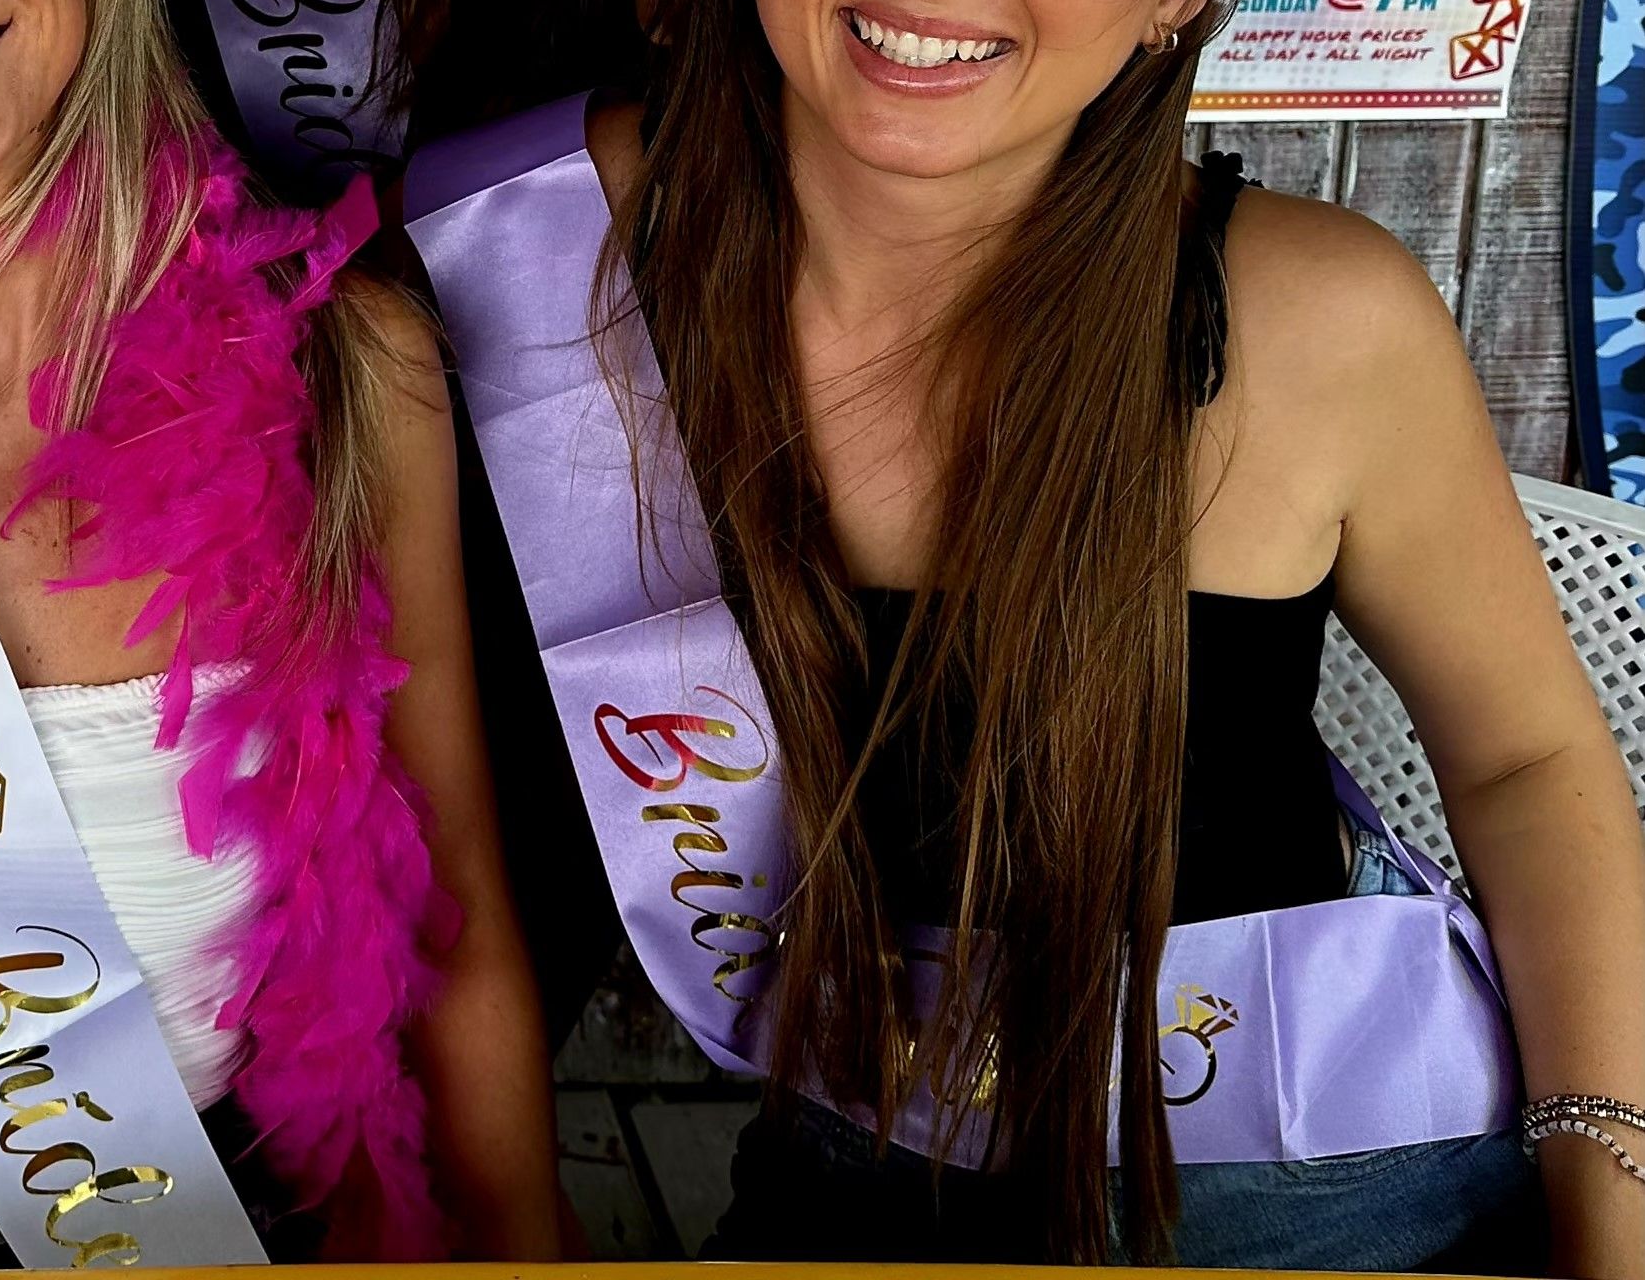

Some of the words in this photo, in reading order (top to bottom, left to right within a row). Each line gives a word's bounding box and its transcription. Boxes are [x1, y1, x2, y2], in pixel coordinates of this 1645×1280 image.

[1232, 30, 1295, 43] HAPPY
[1300, 30, 1352, 43] HOUR
[1360, 29, 1429, 43] PRICES
[1219, 49, 1255, 62] ALL
[1264, 49, 1300, 61] DAY
[1325, 48, 1362, 61] ALL
[1370, 47, 1434, 60] NIGHT
